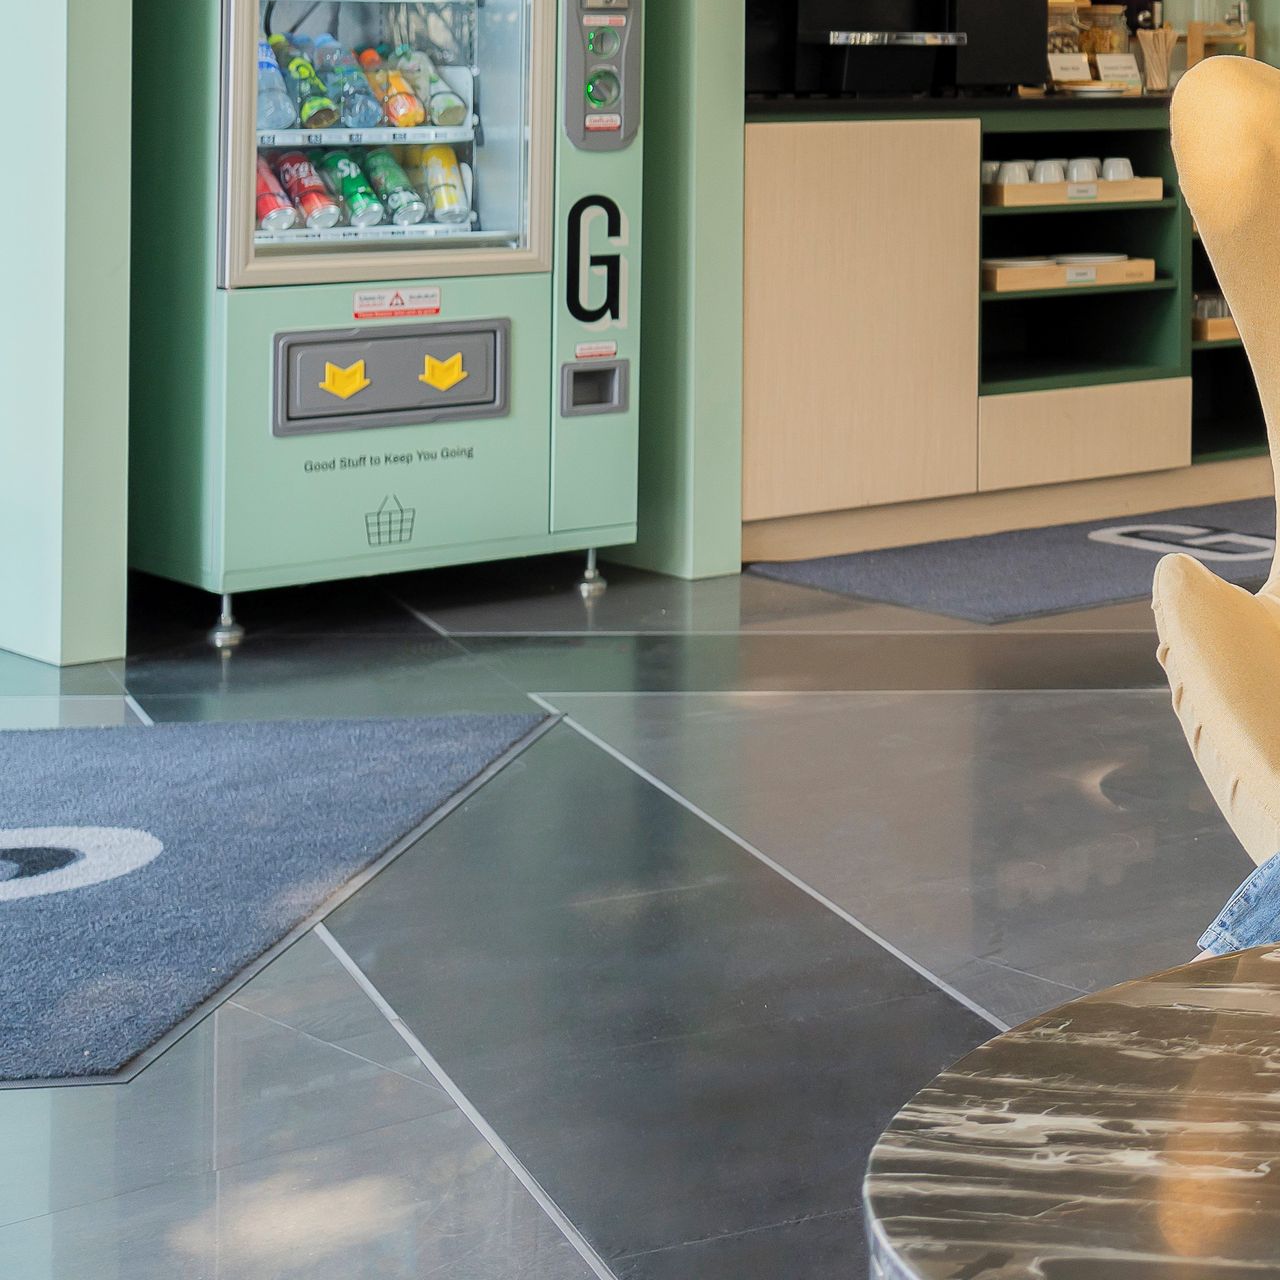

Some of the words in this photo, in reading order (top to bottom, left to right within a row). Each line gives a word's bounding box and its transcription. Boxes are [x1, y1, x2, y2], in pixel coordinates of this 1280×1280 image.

[566, 194, 629, 332] G
[304, 458, 336, 473] Good
[339, 456, 367, 470] Stuff
[370, 454, 381, 466] to
[384, 452, 413, 465] Keep
[416, 449, 438, 462] You
[440, 446, 474, 460] Going
